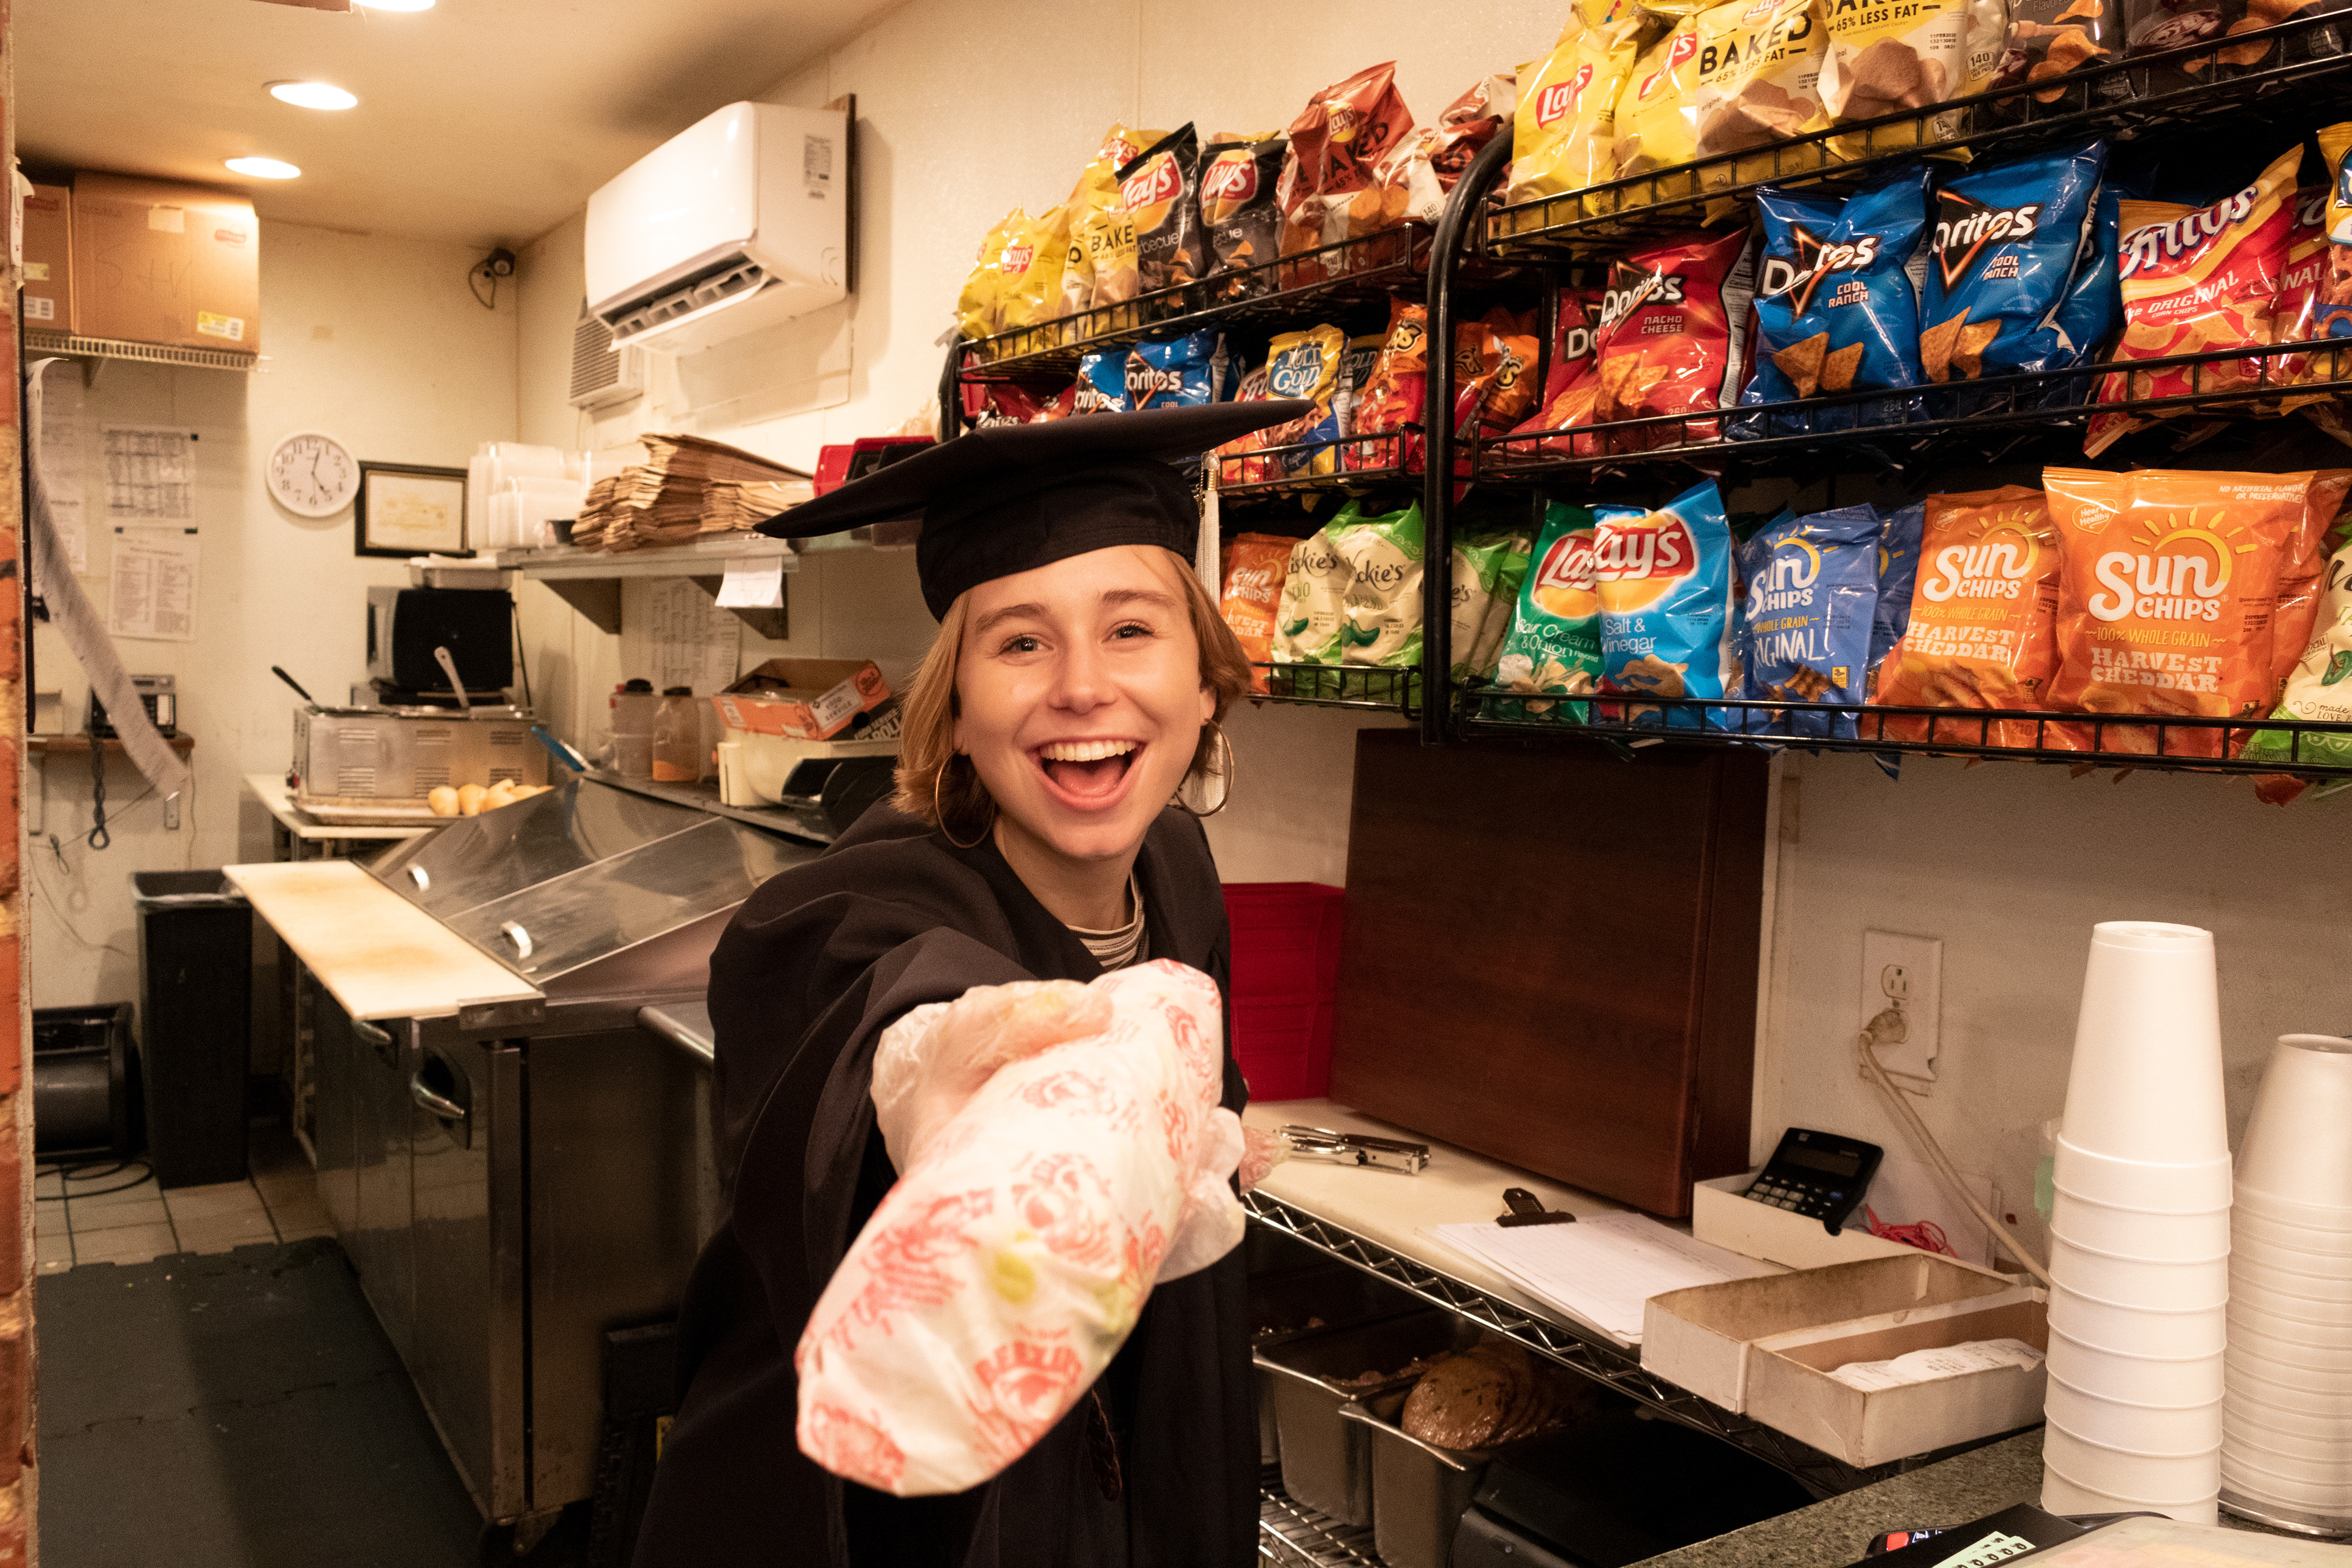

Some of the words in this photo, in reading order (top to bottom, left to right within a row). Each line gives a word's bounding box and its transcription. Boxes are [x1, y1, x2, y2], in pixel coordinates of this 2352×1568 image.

[1837, 16, 1856, 31] 65%
[1861, 9, 1888, 26] LESS
[1895, 4, 1919, 18] FAT
[1700, 10, 1812, 76] BAKED
[1765, 48, 1785, 62] FAT
[1970, 53, 1990, 67] 140
[1122, 162, 1172, 213] Lay's
[2119, 186, 2258, 281] Fritos
[1837, 281, 1868, 296] COOL
[2148, 270, 2240, 313] ORIGINAL
[1828, 290, 1869, 309] RANCH
[1644, 315, 1683, 325] NACHO
[2174, 306, 2198, 315] CHIPS
[1641, 324, 1683, 335] CHEESE
[2079, 513, 2109, 526] Healthy
[1594, 526, 1683, 582] Lay's
[1923, 543, 2032, 602] Sun
[1957, 579, 2021, 599] CHIPS
[2088, 551, 2226, 622] Sun
[1921, 605, 1946, 619] 100%
[1947, 606, 1976, 620] WHOLE
[1980, 607, 2009, 622] GRAIN
[2135, 597, 2221, 621] CHIPS
[1605, 618, 1631, 635] Salt
[1635, 619, 1646, 632] &
[1781, 615, 1808, 630] GRAIN
[1543, 624, 1596, 649] Cream
[1906, 621, 2015, 646] HARVEST
[2097, 627, 2125, 642] 100%
[2128, 629, 2169, 646] WHOLE
[2171, 631, 2211, 647] GRAIN
[1903, 638, 2010, 663] CHEDDAR
[2090, 647, 2222, 674] HARVEST
[2090, 666, 2219, 693] CHEDDAR
[2316, 711, 2342, 722] LOVE
[2319, 704, 2350, 714] made
